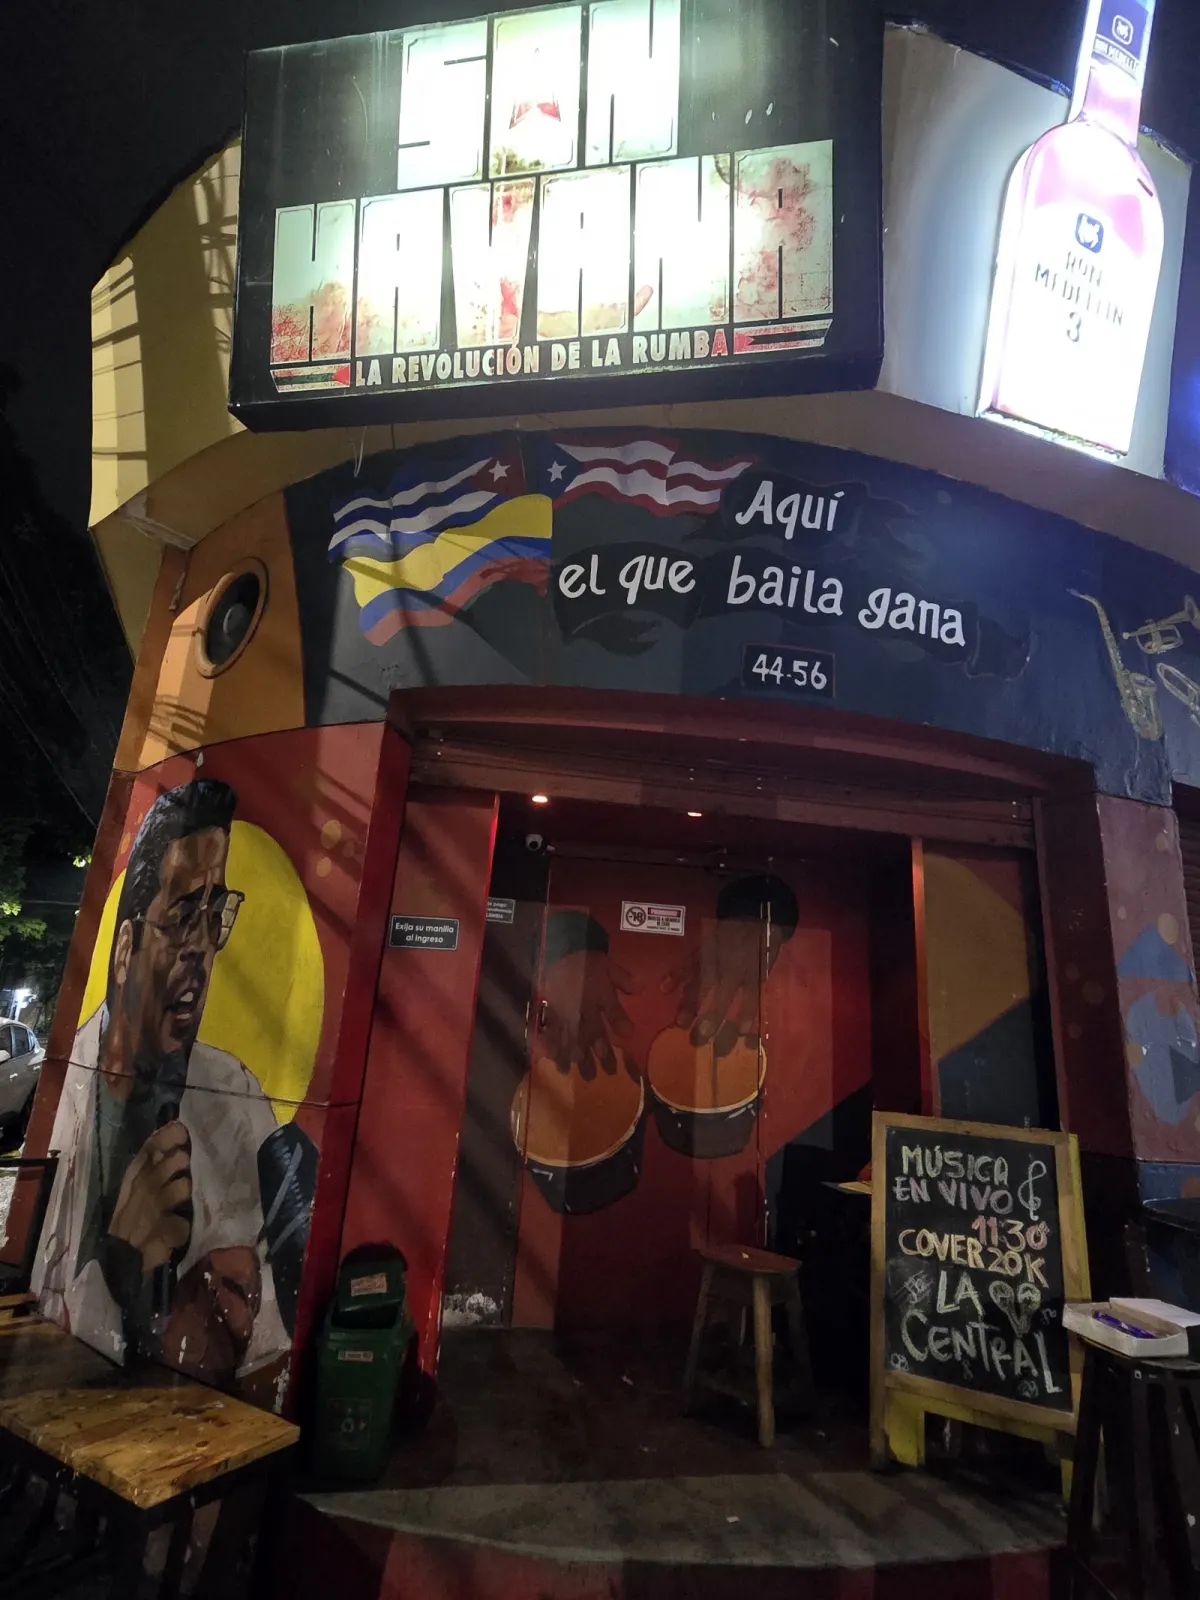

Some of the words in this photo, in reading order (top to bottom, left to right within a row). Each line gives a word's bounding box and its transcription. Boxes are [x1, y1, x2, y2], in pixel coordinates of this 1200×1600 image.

[270, 140, 833, 365] HAVANA
[355, 361, 382, 387] LA
[392, 342, 539, 384] REVOLUCIÓN
[552, 341, 580, 364] DE
[591, 337, 621, 366] LA
[632, 328, 729, 364] RUMBA
[735, 480, 845, 540] Aquí
[558, 554, 606, 599] el
[618, 554, 696, 605] que
[726, 554, 844, 617] baila
[858, 587, 966, 648] gana
[751, 653, 828, 691] 44-56
[395, 922, 414, 932] Exija
[425, 925, 455, 933] manilla
[405, 934, 414, 942] al
[902, 1144, 1009, 1187] MÚSICA
[893, 1176, 931, 1204] EN
[937, 1178, 1013, 1215] VIVO
[898, 1228, 985, 1269] COVER
[937, 1270, 985, 1316] LA
